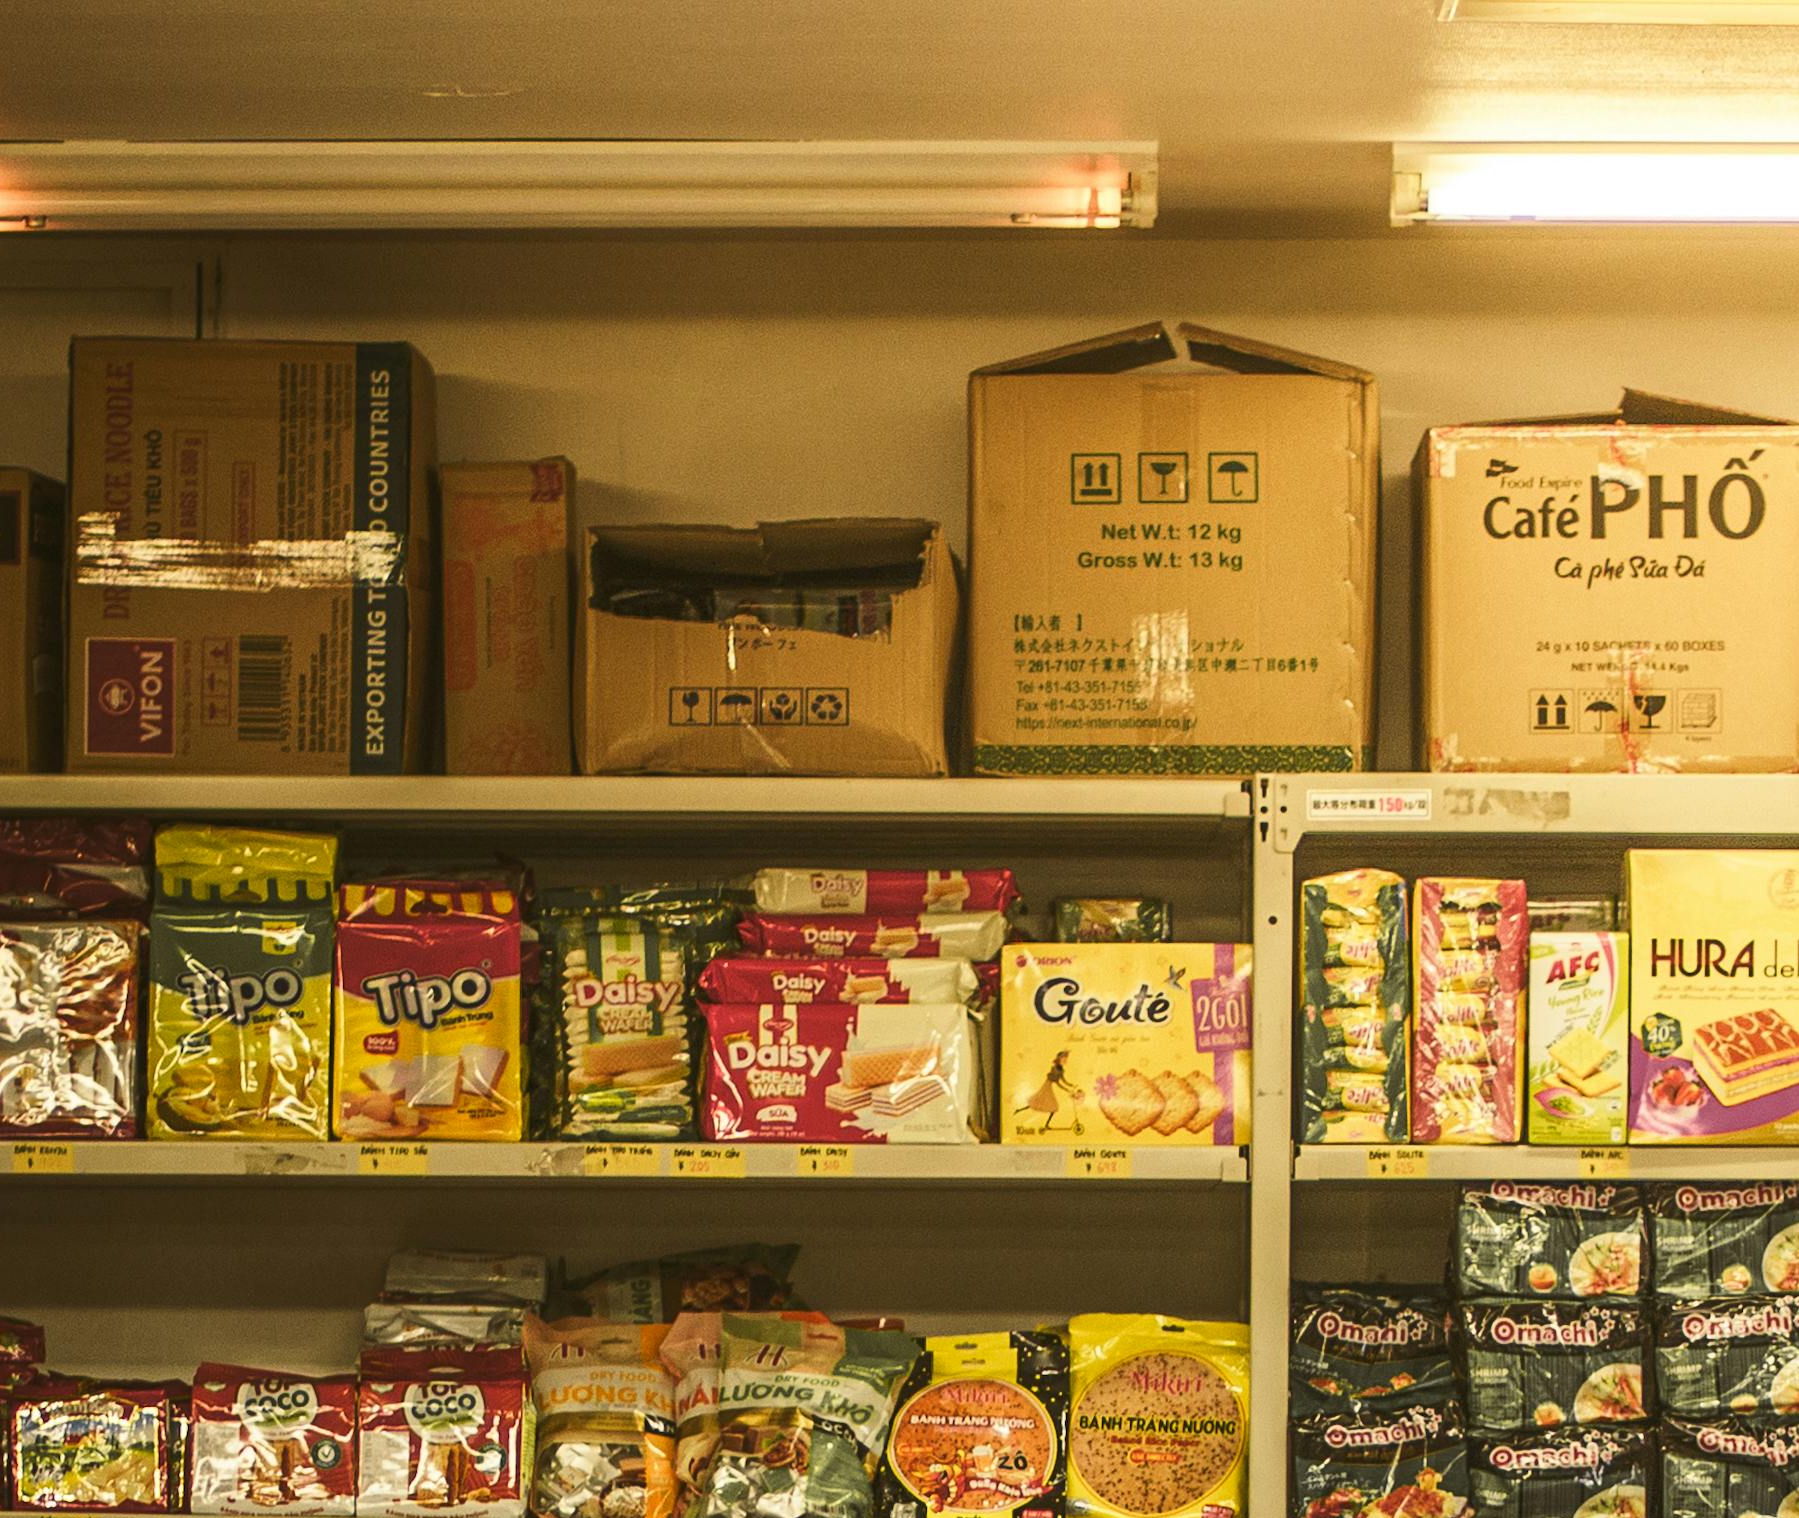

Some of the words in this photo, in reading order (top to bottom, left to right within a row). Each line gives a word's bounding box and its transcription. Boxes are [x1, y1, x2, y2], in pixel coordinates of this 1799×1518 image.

[367, 367, 390, 504] COUNTRIES
[1499, 475, 1534, 490] Food
[1482, 492, 1580, 541] Café
[1101, 523, 1137, 541] Net
[1141, 523, 1181, 541] W.t:
[1187, 523, 1212, 541] 12
[1216, 522, 1242, 545] kg
[1076, 550, 1137, 569] Gross
[1143, 551, 1182, 569] W.t:
[1188, 551, 1213, 569] 13
[1218, 551, 1243, 572] kg
[1535, 640, 1552, 653] 24
[1553, 642, 1563, 656] g
[1574, 640, 1590, 653] 10
[1682, 640, 1726, 653] BOXES
[364, 608, 388, 757] EXPORTING
[1570, 661, 1594, 674] NET
[139, 649, 164, 743] VIFON
[809, 873, 862, 896] Daisy
[803, 926, 857, 948] Daisy
[1545, 948, 1600, 985] AFC
[1649, 936, 1756, 979] HURA
[363, 967, 491, 1029] Tipo
[571, 975, 682, 1013] Daisy
[772, 971, 826, 995] Daisy
[1032, 975, 1174, 1027] Gouté
[727, 1038, 832, 1078] Daisy
[747, 1069, 806, 1087] CREAM
[749, 1082, 807, 1098] WAFER
[1490, 1179, 1598, 1210] Omachi
[1674, 1184, 1784, 1214] Omachi
[1490, 1316, 1598, 1346] Omachi
[1681, 1307, 1792, 1340] Omachi
[774, 1374, 798, 1388] DRY
[800, 1375, 841, 1389] FOOD
[410, 1393, 478, 1420] COCO
[910, 1412, 948, 1427] BÁNH
[1078, 1412, 1122, 1434] BÁNH
[1324, 1419, 1425, 1449] Omachi
[1488, 1440, 1600, 1470] Omachi
